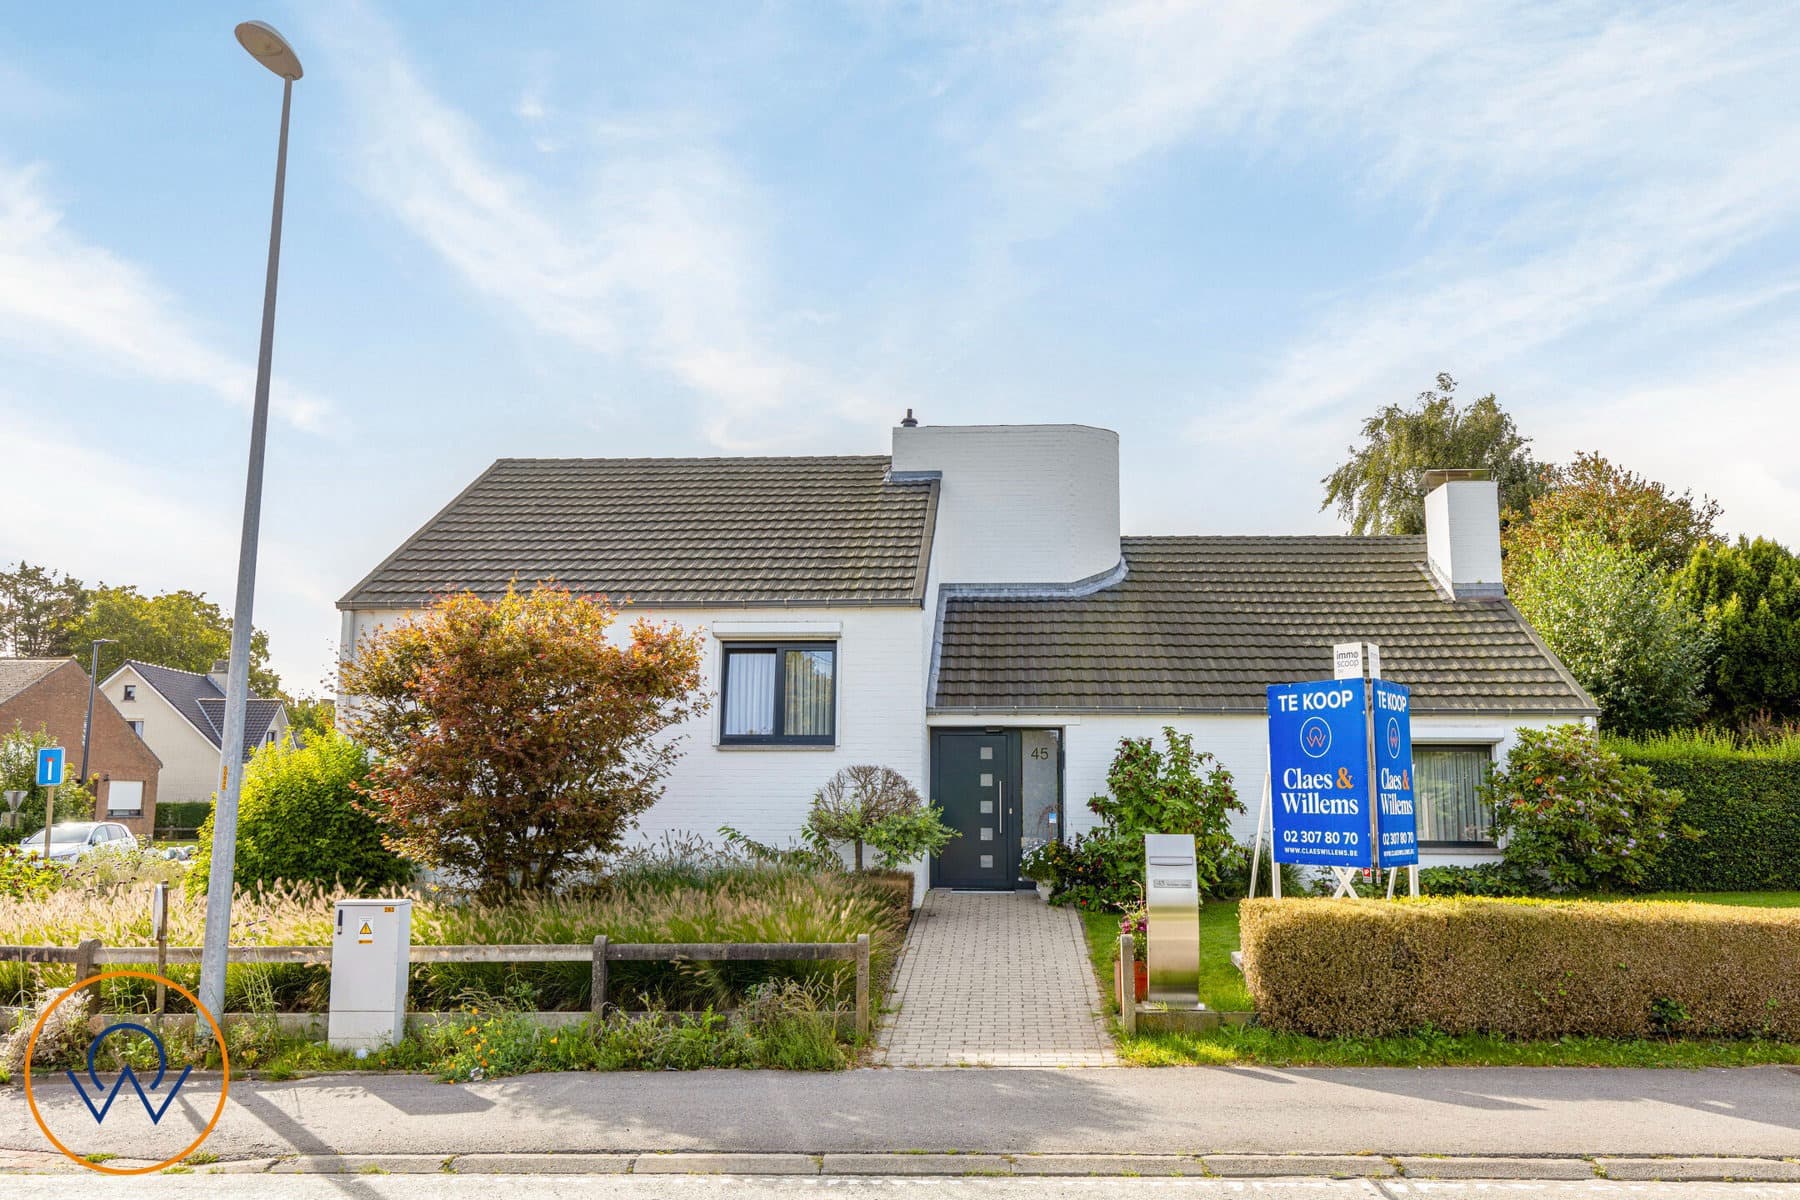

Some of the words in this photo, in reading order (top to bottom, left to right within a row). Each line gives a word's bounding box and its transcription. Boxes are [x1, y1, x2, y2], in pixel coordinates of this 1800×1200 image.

[1336, 650, 1359, 660] immo
[1336, 660, 1360, 668] scoop
[1277, 694, 1298, 713] TE
[1302, 689, 1353, 711] KOOP
[1376, 690, 1387, 709] TE
[1387, 692, 1407, 713] KOOP
[1030, 747, 1049, 760] 45
[1283, 767, 1333, 790] Claes
[1336, 767, 1354, 789] &
[1381, 767, 1402, 790] Claes
[1402, 769, 1410, 791] &
[1280, 792, 1359, 815] Willems
[1380, 792, 1414, 815] Willems
[1283, 830, 1298, 843] 02
[1300, 831, 1322, 843] 307
[1324, 831, 1340, 844] 80
[1342, 832, 1359, 845] 70
[1382, 832, 1390, 846] 02
[1390, 831, 1400, 845] 307
[1400, 831, 1407, 845] 80
[1407, 831, 1415, 844] 70
